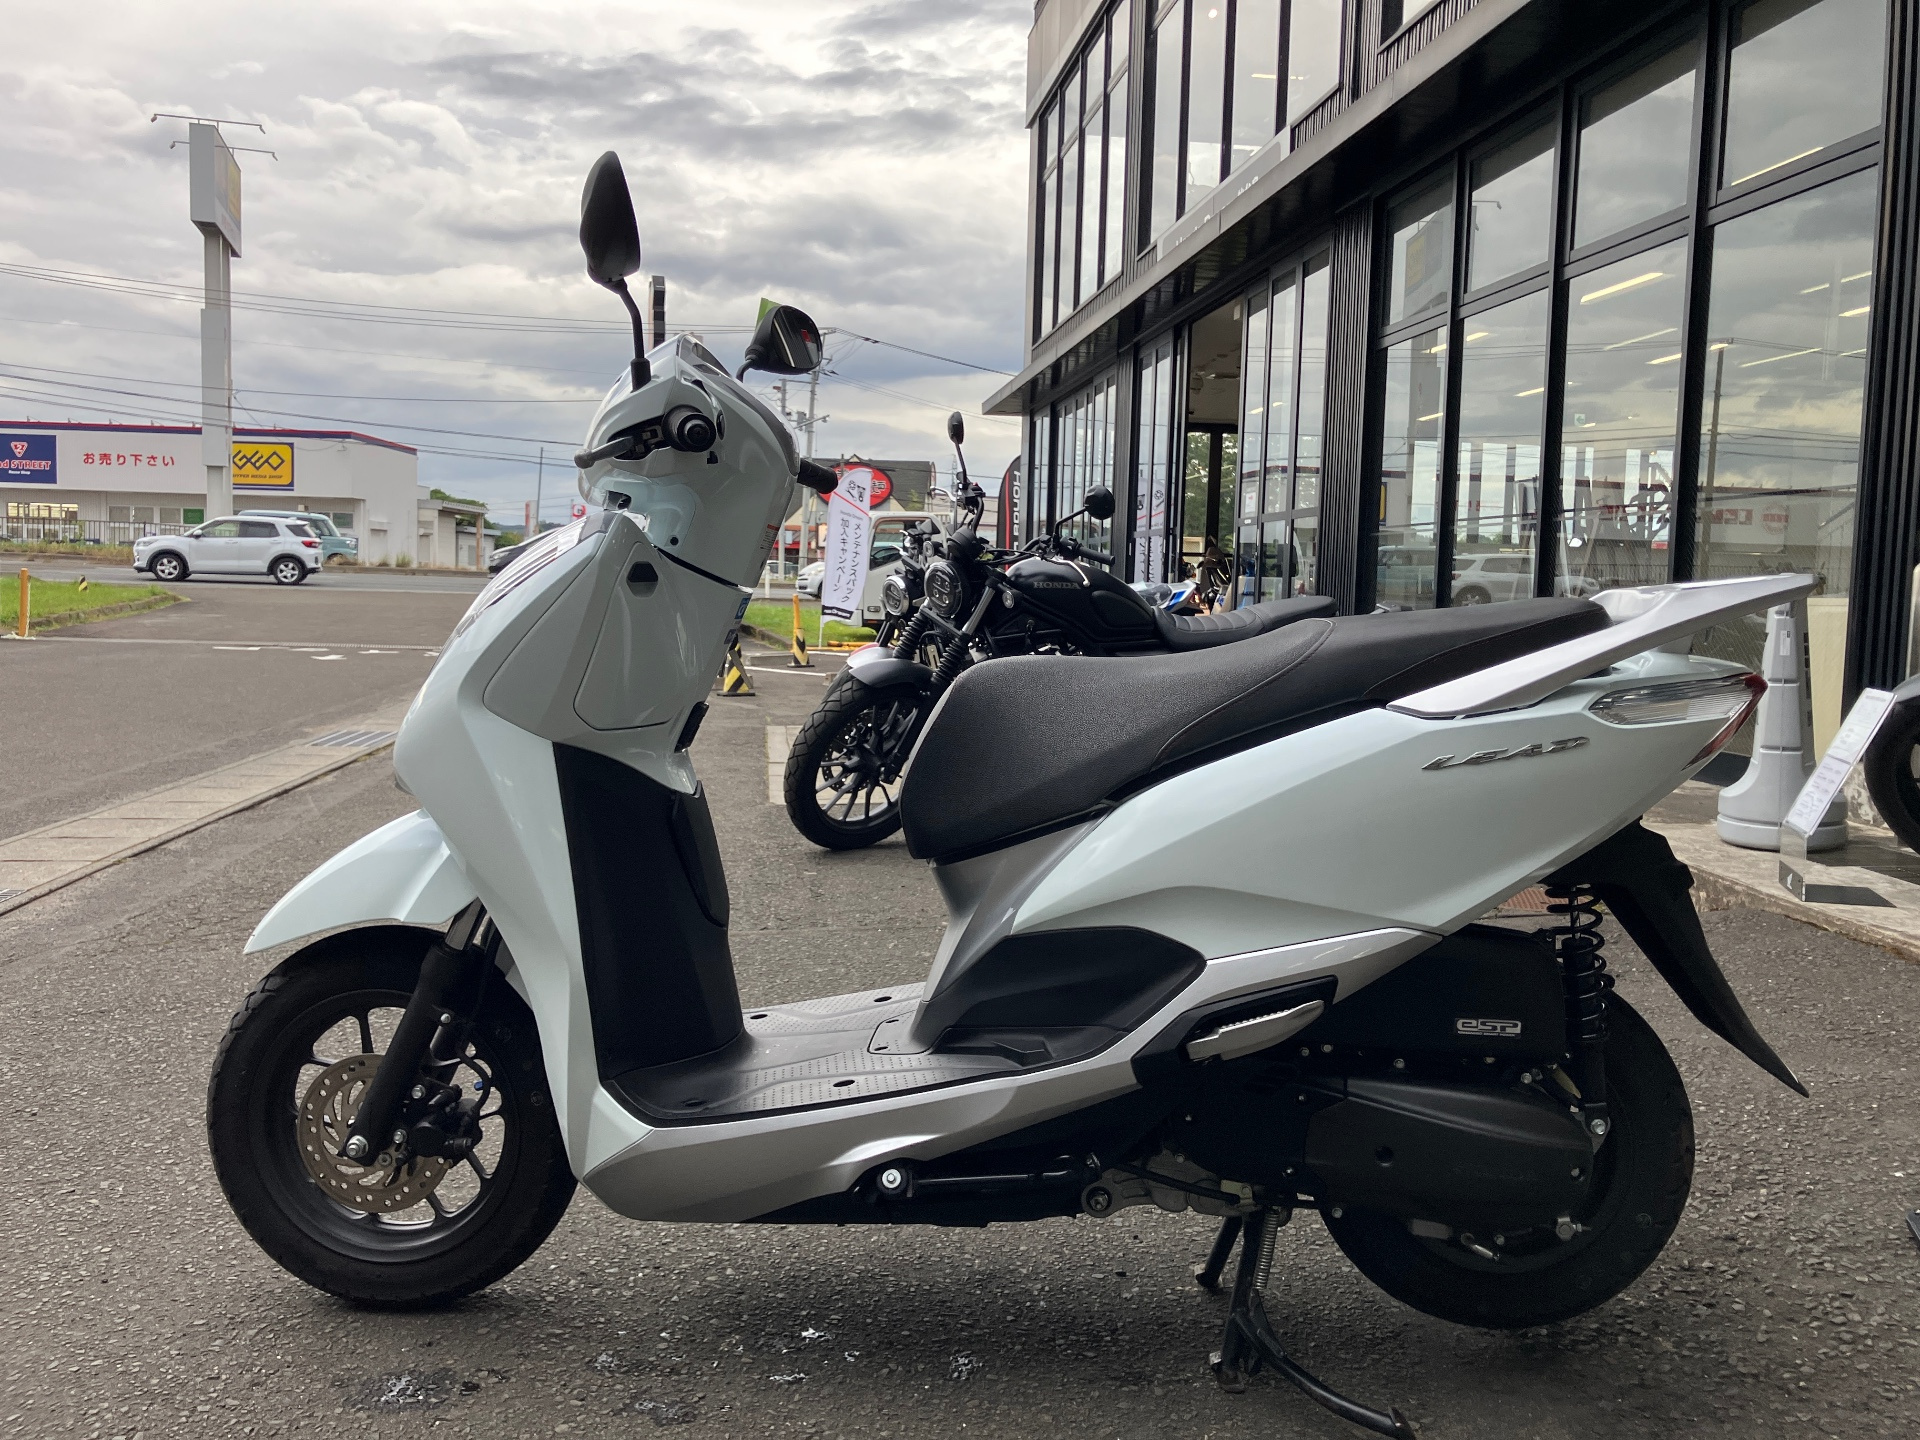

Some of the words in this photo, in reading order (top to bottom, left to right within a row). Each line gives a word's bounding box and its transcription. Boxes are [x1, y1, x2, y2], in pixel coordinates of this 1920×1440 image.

[11, 460, 51, 470] STREET
[83, 452, 175, 467] お売り下さい
[833, 518, 850, 592] 加入キャンペーン
[841, 523, 862, 603] メンテナンスパック
[1033, 581, 1081, 590] HONDA
